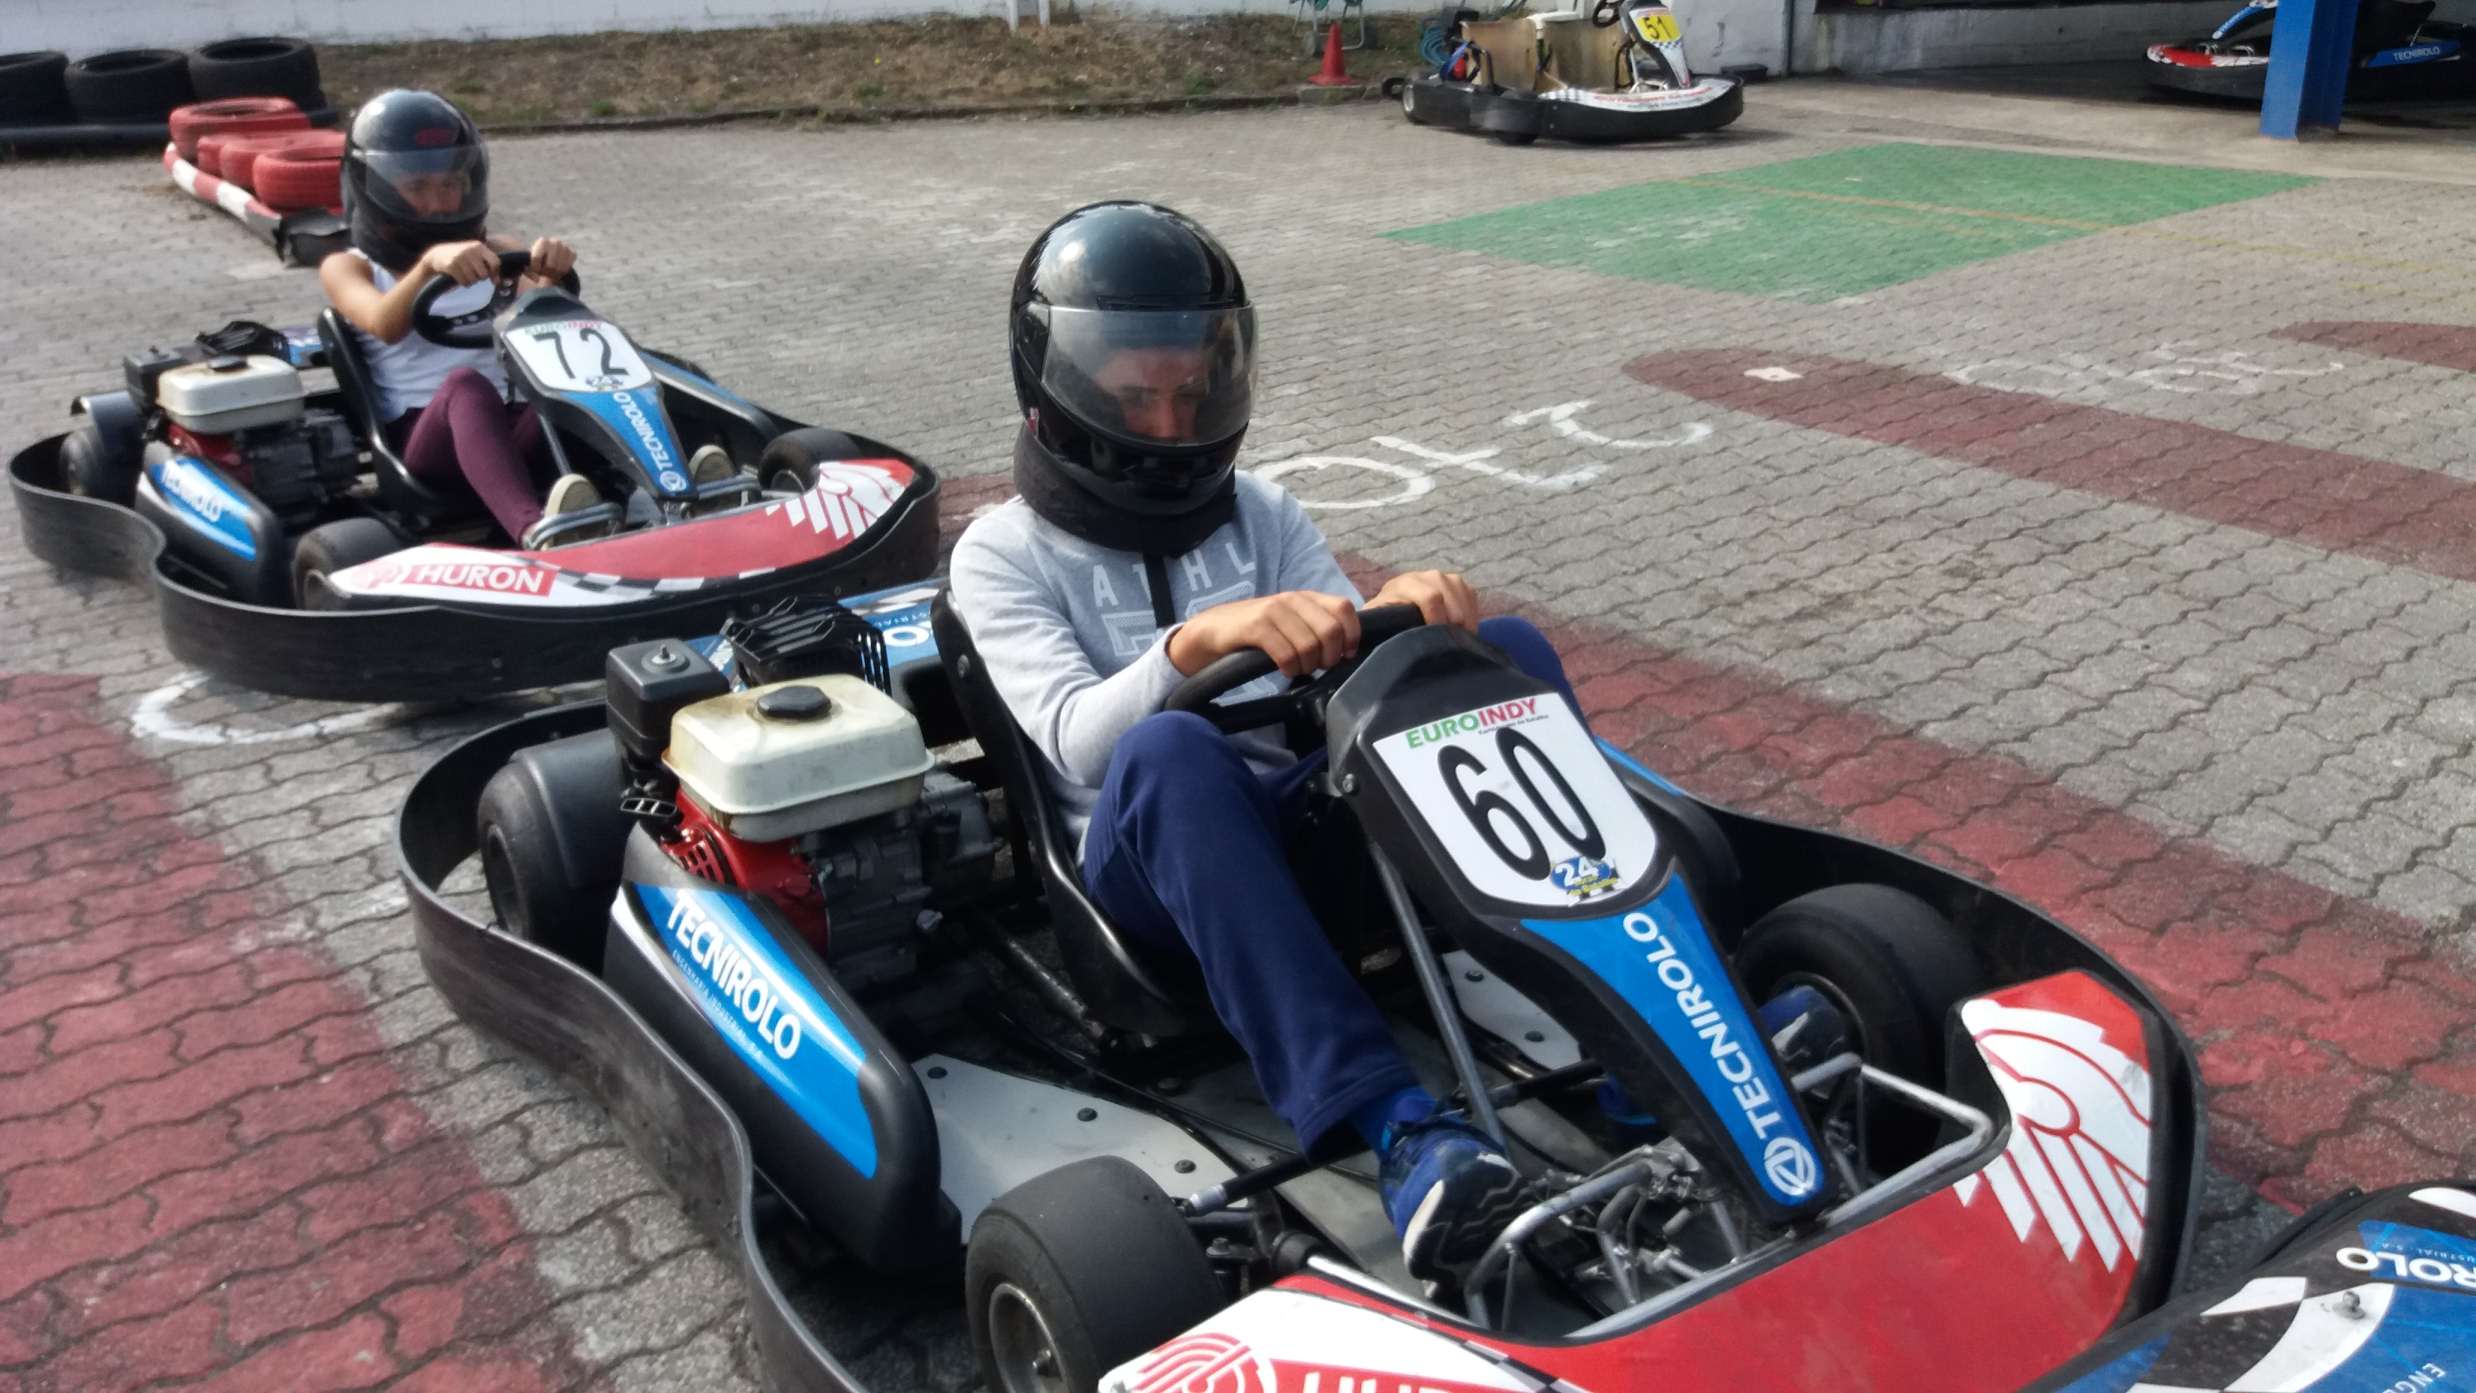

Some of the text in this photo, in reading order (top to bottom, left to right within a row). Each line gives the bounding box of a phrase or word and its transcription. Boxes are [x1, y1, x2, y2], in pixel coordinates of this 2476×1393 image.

[1642, 15, 1672, 40] 51
[533, 327, 630, 380] 72
[613, 391, 674, 471] TECNIROLO
[414, 564, 545, 594] HURON
[1405, 698, 1538, 750] EUROINDY
[1437, 726, 1607, 882] 60
[667, 888, 802, 1061] TECNIROLO
[1622, 912, 1782, 1140] TECNIROLO
